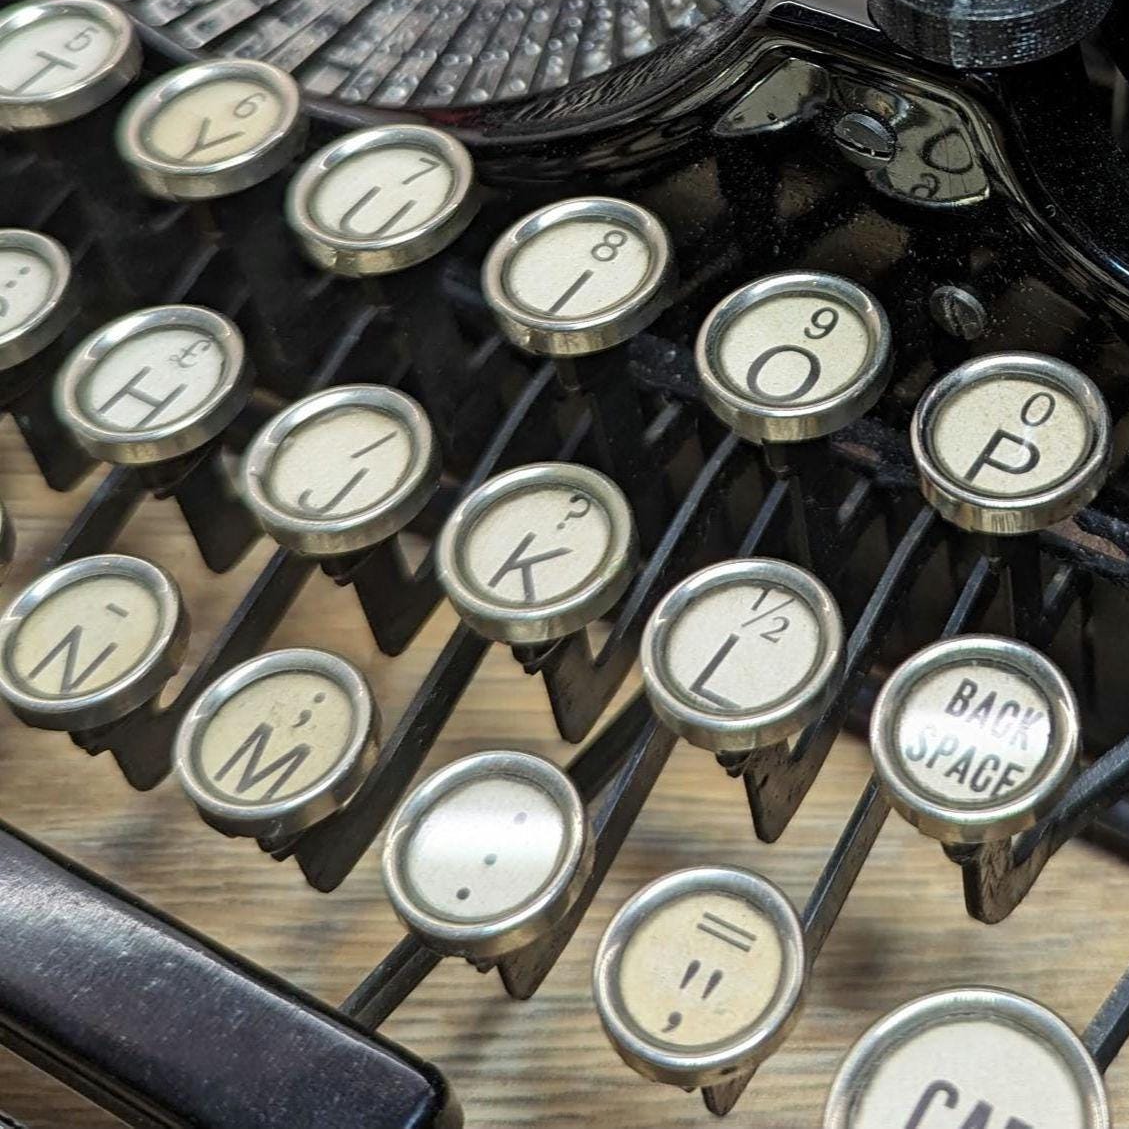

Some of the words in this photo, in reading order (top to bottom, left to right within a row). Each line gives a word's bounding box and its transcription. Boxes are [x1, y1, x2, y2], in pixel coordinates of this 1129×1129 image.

[64, 25, 99, 52] 5
[13, 50, 80, 95] T
[233, 91, 268, 120] 6
[180, 116, 245, 161] Y
[401, 156, 441, 186] 7
[338, 186, 419, 237] U
[590, 228, 629, 263] 8
[802, 306, 841, 340] 9
[168, 337, 214, 369] £
[745, 343, 823, 403] O
[97, 364, 188, 429] H
[962, 428, 1042, 482] P
[555, 492, 593, 531] ?
[486, 531, 573, 603] K
[28, 624, 118, 693] N
[688, 633, 743, 709] L
[944, 676, 1047, 752] BACK
[213, 721, 312, 801] M
[904, 725, 1027, 797] SPACE
